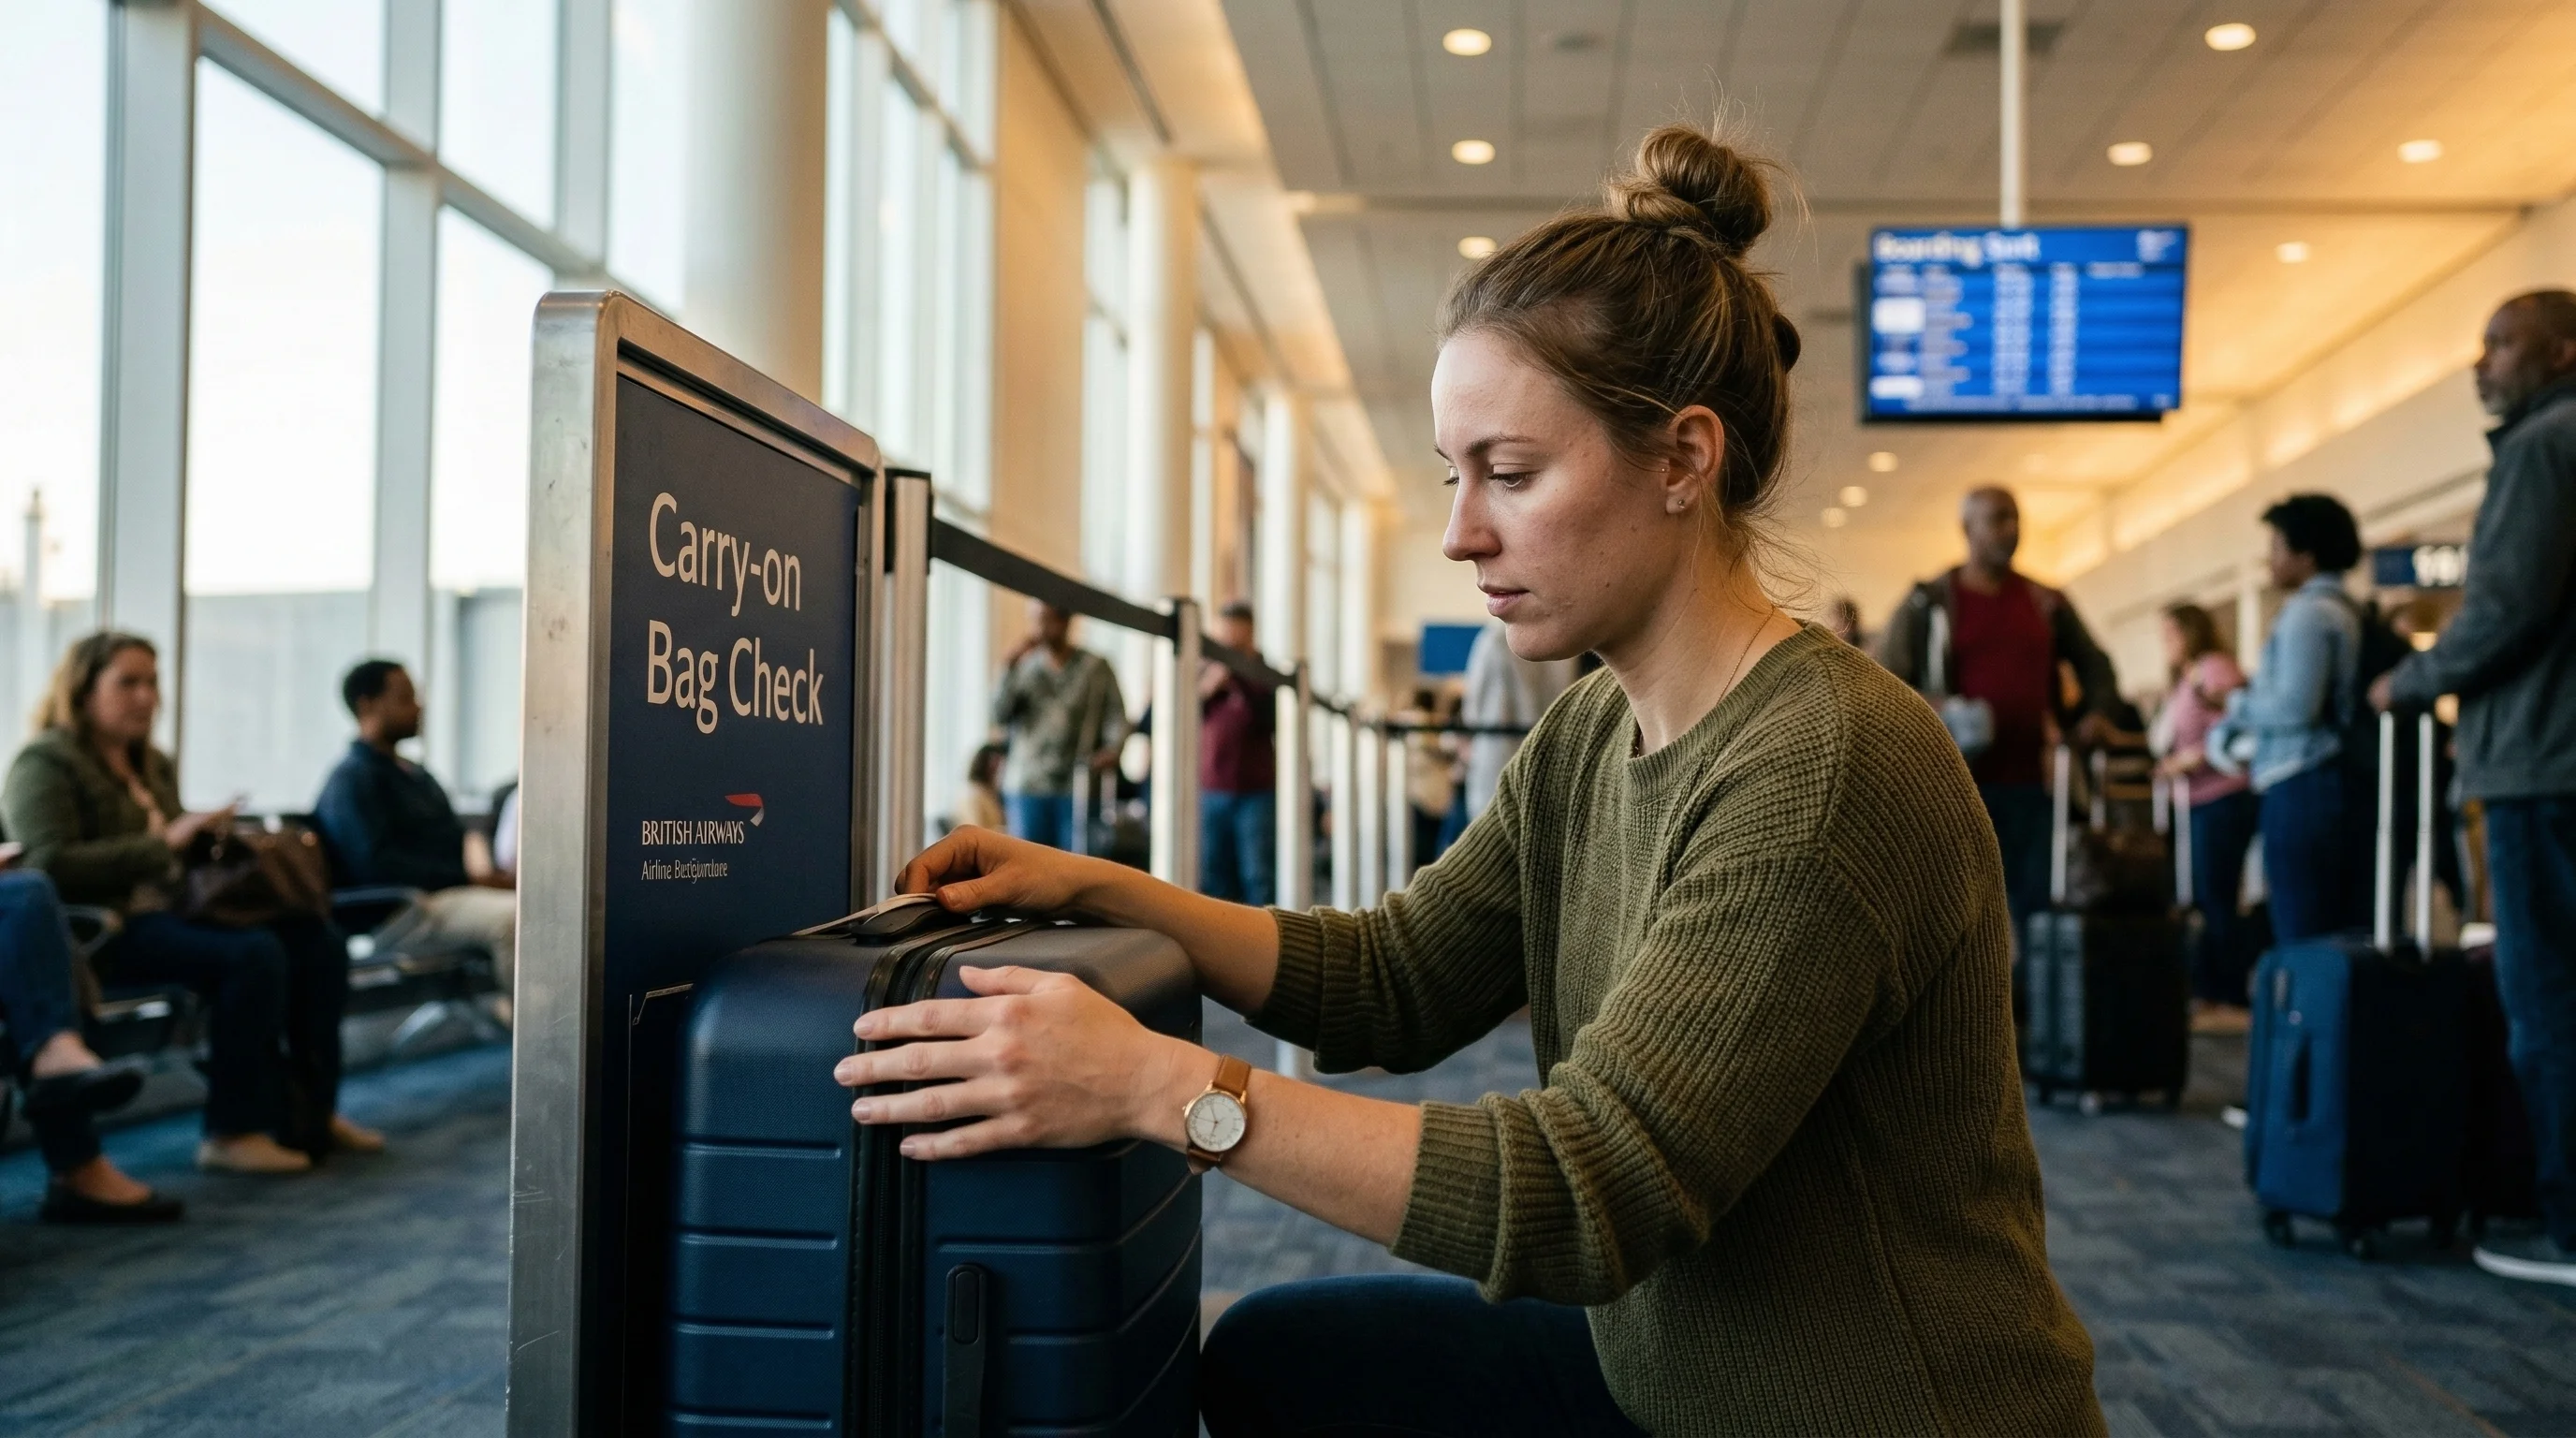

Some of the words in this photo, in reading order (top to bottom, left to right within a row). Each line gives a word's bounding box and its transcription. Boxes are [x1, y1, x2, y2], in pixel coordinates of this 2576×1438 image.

[650, 492, 801, 617] Carry-on
[647, 620, 719, 734] Bag
[729, 637, 824, 726] Check
[642, 820, 693, 845] BRITISH
[694, 820, 745, 844] AIRWAYS
